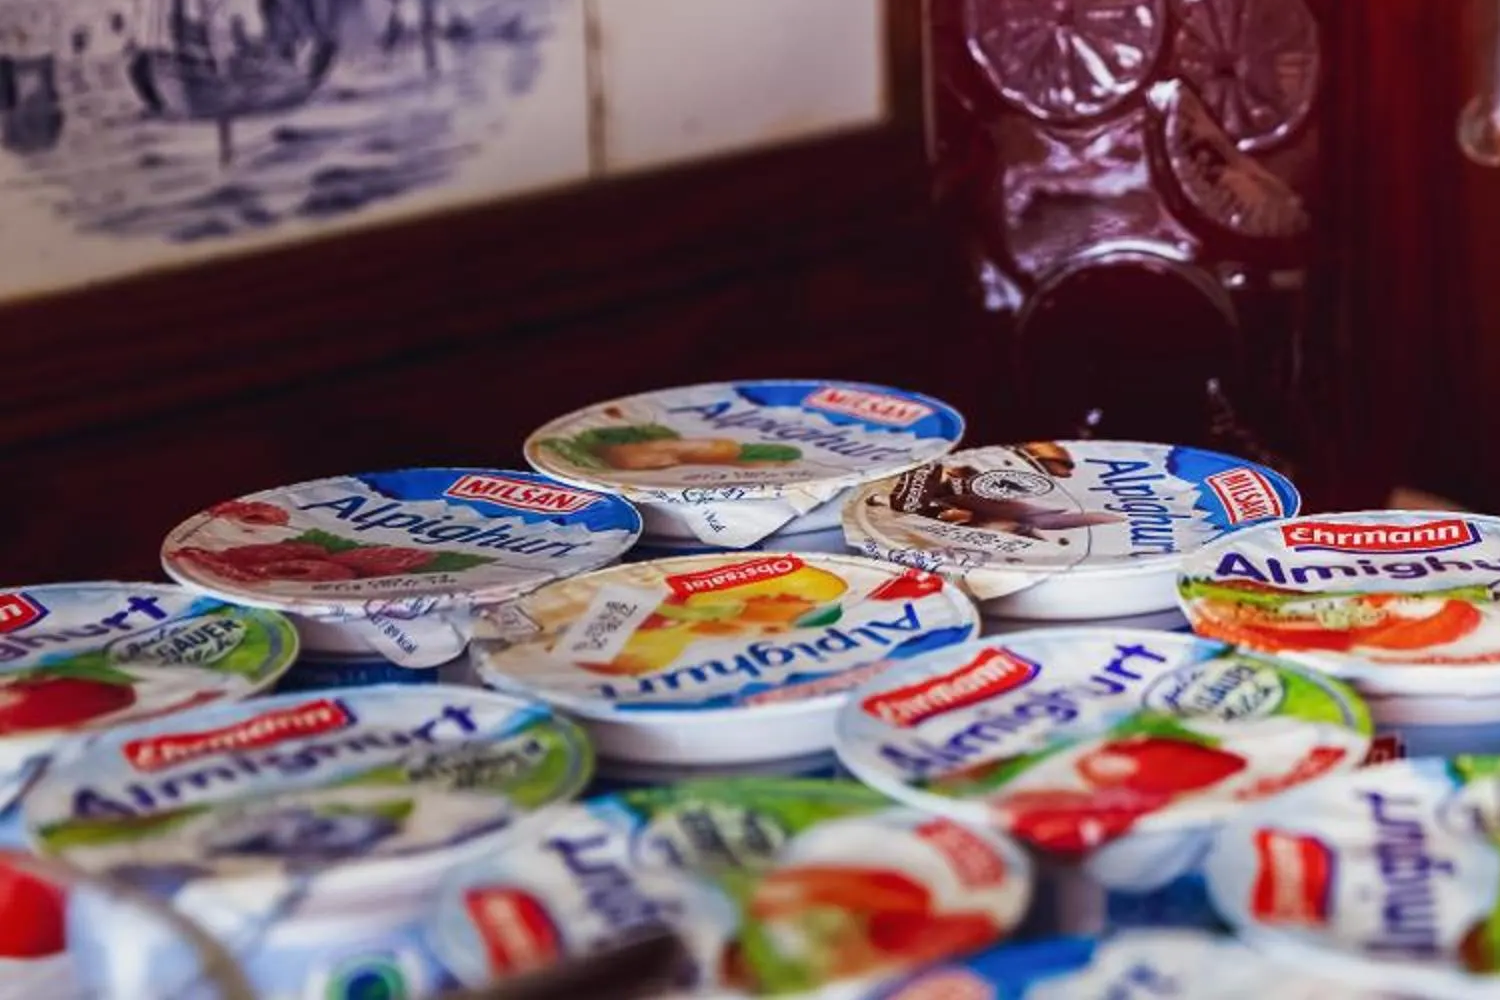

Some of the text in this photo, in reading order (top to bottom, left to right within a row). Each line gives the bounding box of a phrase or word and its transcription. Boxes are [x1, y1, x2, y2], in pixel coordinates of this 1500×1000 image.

[463, 478, 579, 509] MILSAN
[300, 495, 592, 558] Alpighurt
[1290, 523, 1460, 545] Ehrmann
[684, 561, 793, 591] Obstsalat
[0, 596, 168, 662] ghurt
[589, 602, 923, 702] Alpighurt
[73, 705, 477, 816] Almighurt
